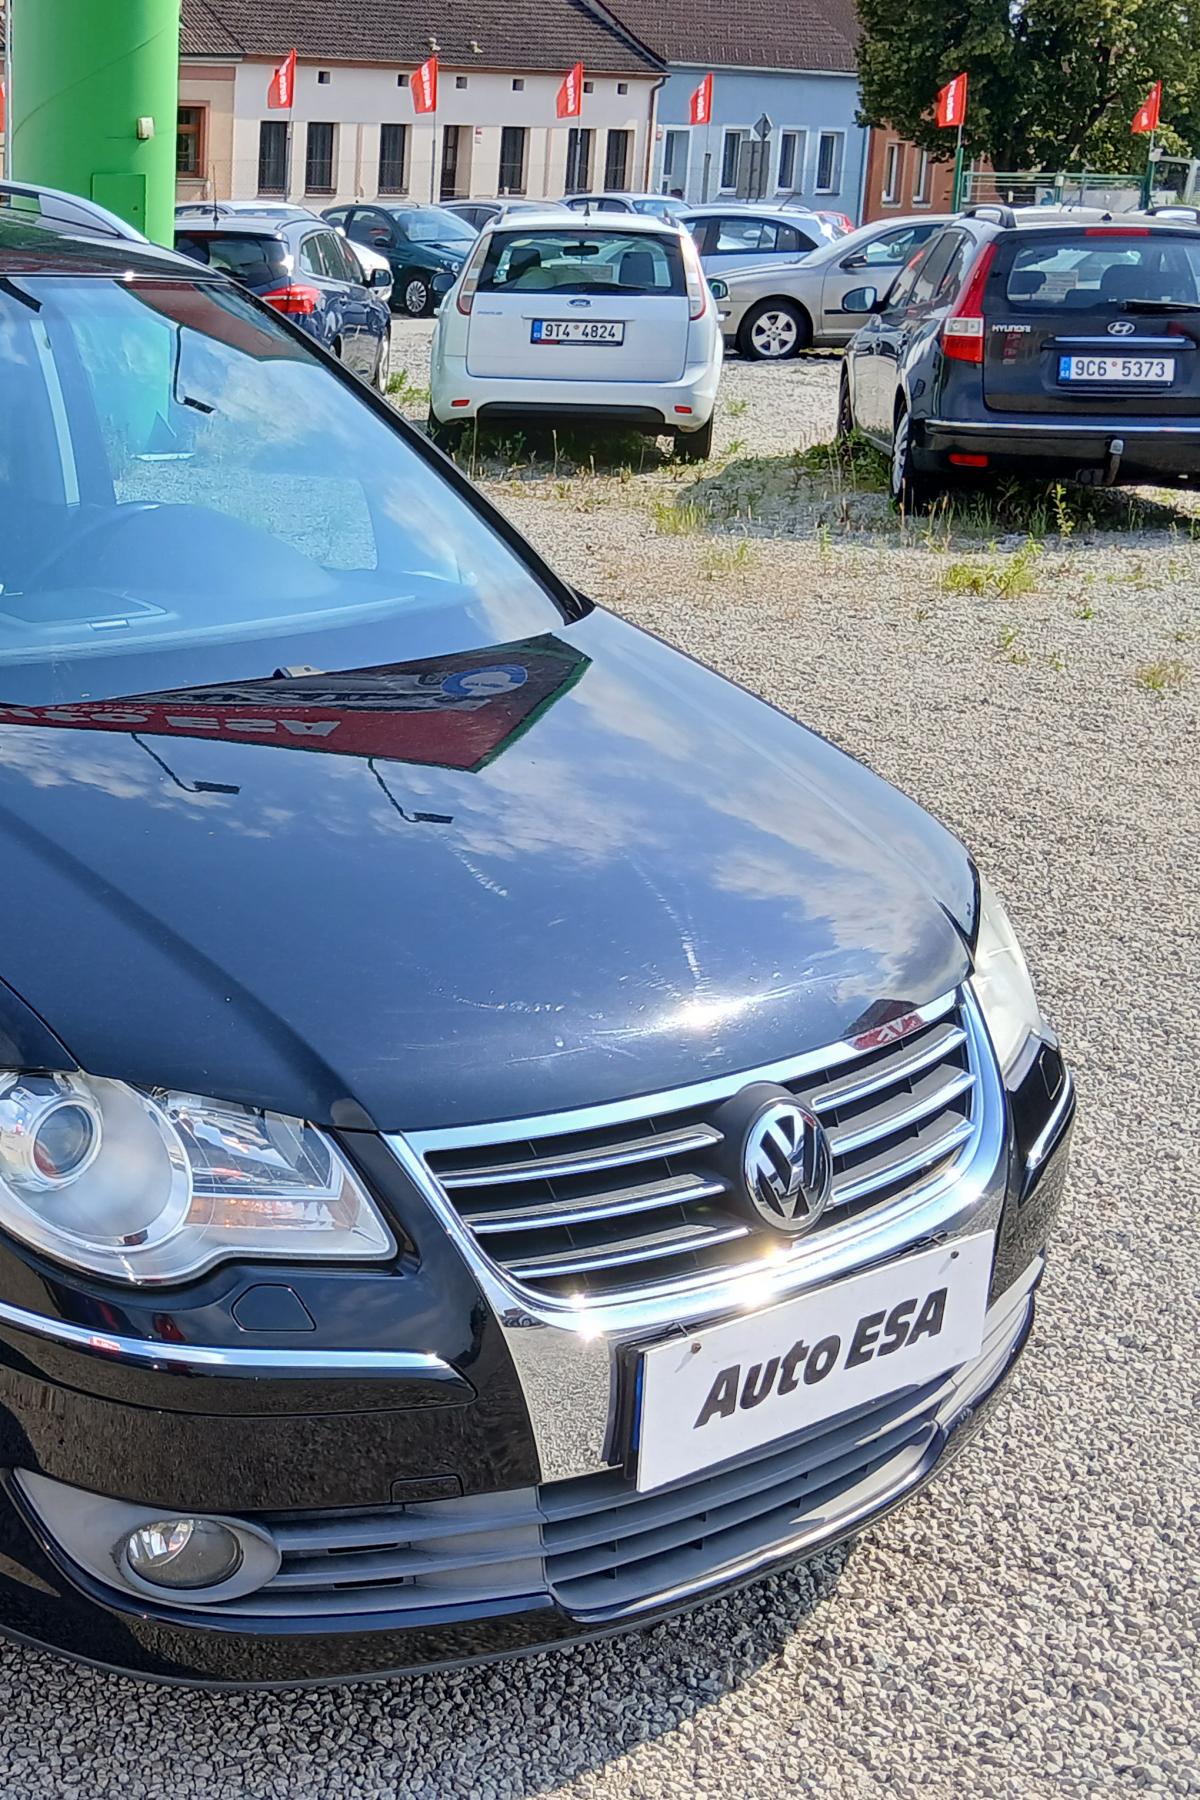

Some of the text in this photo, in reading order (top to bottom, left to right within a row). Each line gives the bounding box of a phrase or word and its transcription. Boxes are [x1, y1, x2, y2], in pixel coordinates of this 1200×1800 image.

[544, 323, 616, 339] 9T4 4824
[992, 324, 1031, 333] HYUNDAI
[1074, 359, 1166, 378] 9C6 5373
[693, 1286, 949, 1430] Auto ESA
